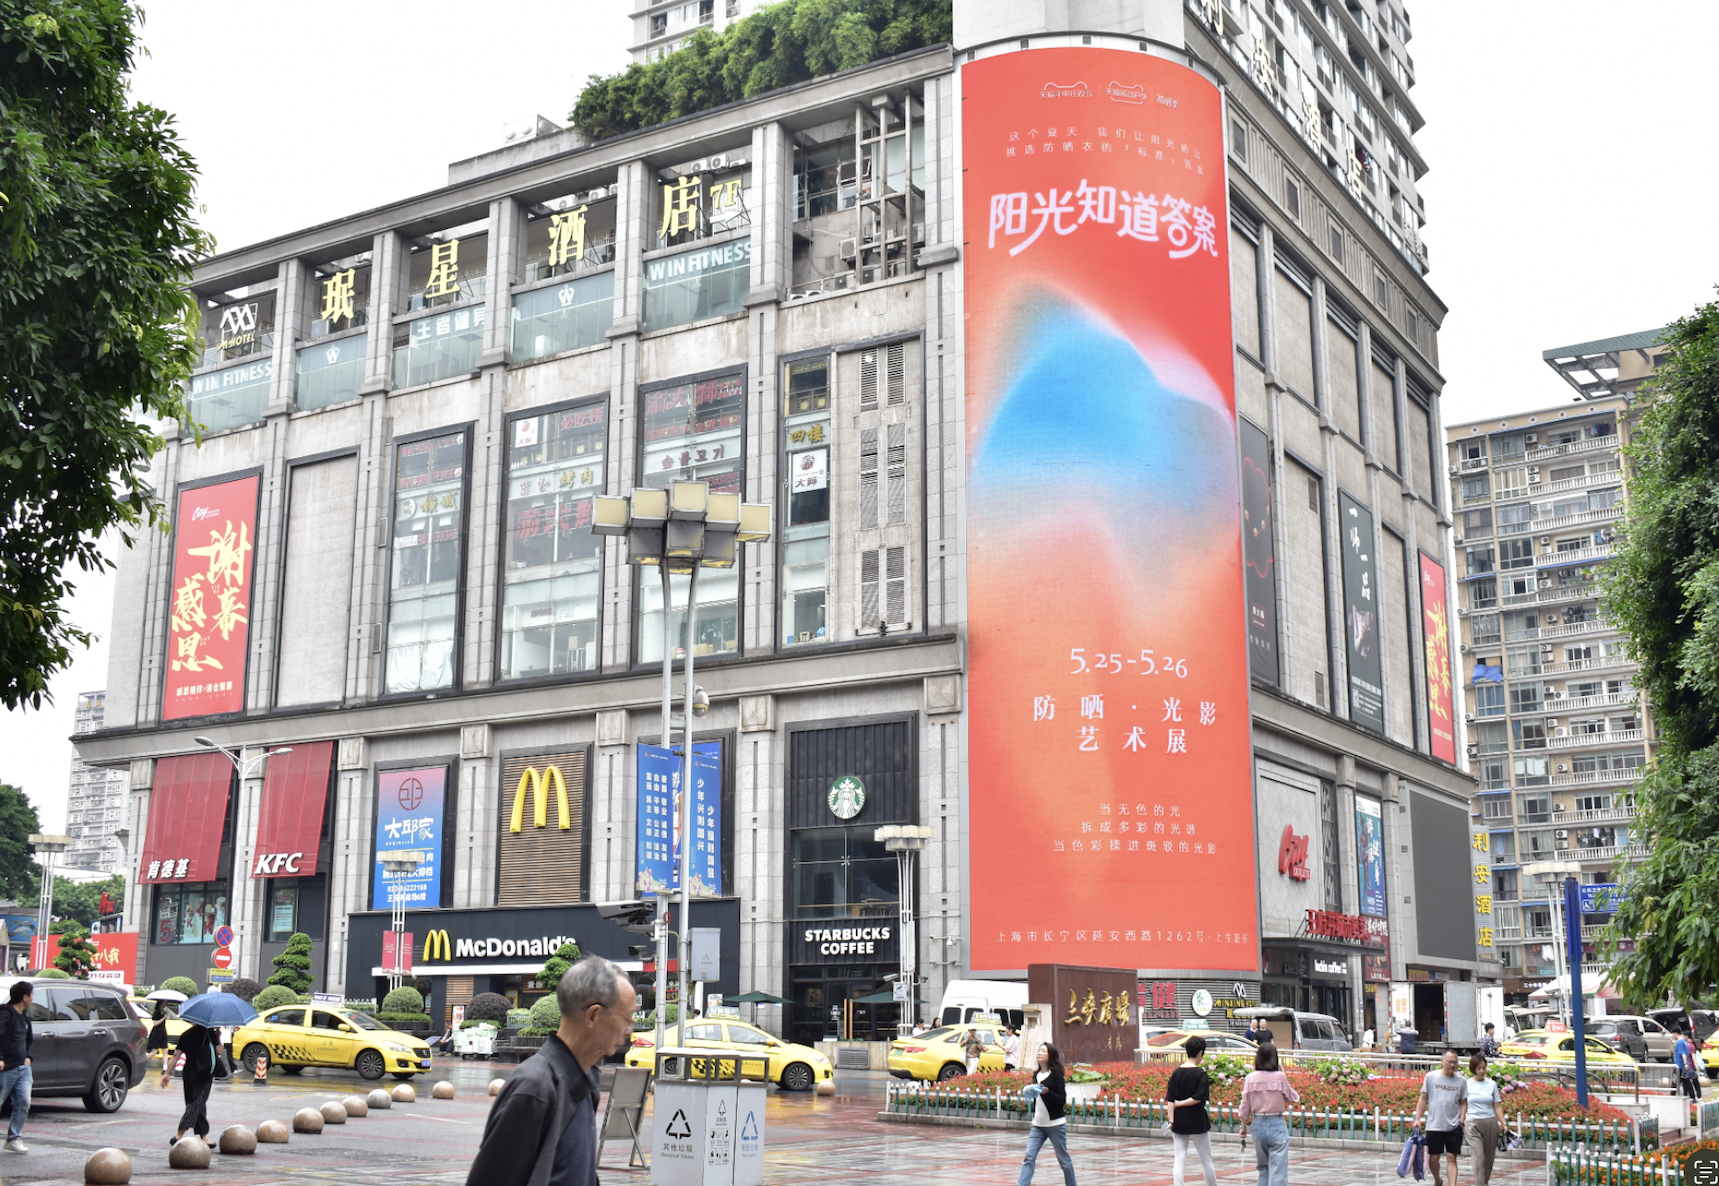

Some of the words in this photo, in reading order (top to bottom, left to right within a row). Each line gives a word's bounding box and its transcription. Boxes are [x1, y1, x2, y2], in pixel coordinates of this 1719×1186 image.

[1009, 127, 1078, 142] 这个夏天
[1097, 127, 1202, 160] 我们让阳光晒出
[709, 179, 742, 209] 7F
[988, 178, 1220, 259] 阳光知道答案
[649, 262, 685, 281] WIN
[687, 242, 752, 273] FITNESS
[192, 375, 219, 395] WIN
[790, 423, 825, 444] 四楼
[187, 520, 251, 641] 谢幕
[171, 573, 223, 672] 感恩
[1070, 648, 1188, 678] 5.25-5.26
[1077, 726, 1187, 754] 艺术展
[697, 778, 705, 851] 少年兴则国兴
[1100, 803, 1180, 817] 当无色的光
[384, 816, 434, 844] 大邱家
[707, 805, 715, 878] 少年强则国强
[1081, 821, 1196, 835] 拆成多彩的光谱
[1053, 839, 1217, 854] 当色彩揉进斑驳的光影
[147, 858, 190, 880] 肯德基
[255, 852, 303, 875] KFC
[1472, 832, 1494, 948] 利安酒店
[455, 936, 576, 958] McDonald's
[804, 927, 891, 941] STARBUCKS
[820, 941, 875, 955] COFFEE
[663, 1142, 693, 1153] 其他垃圾
